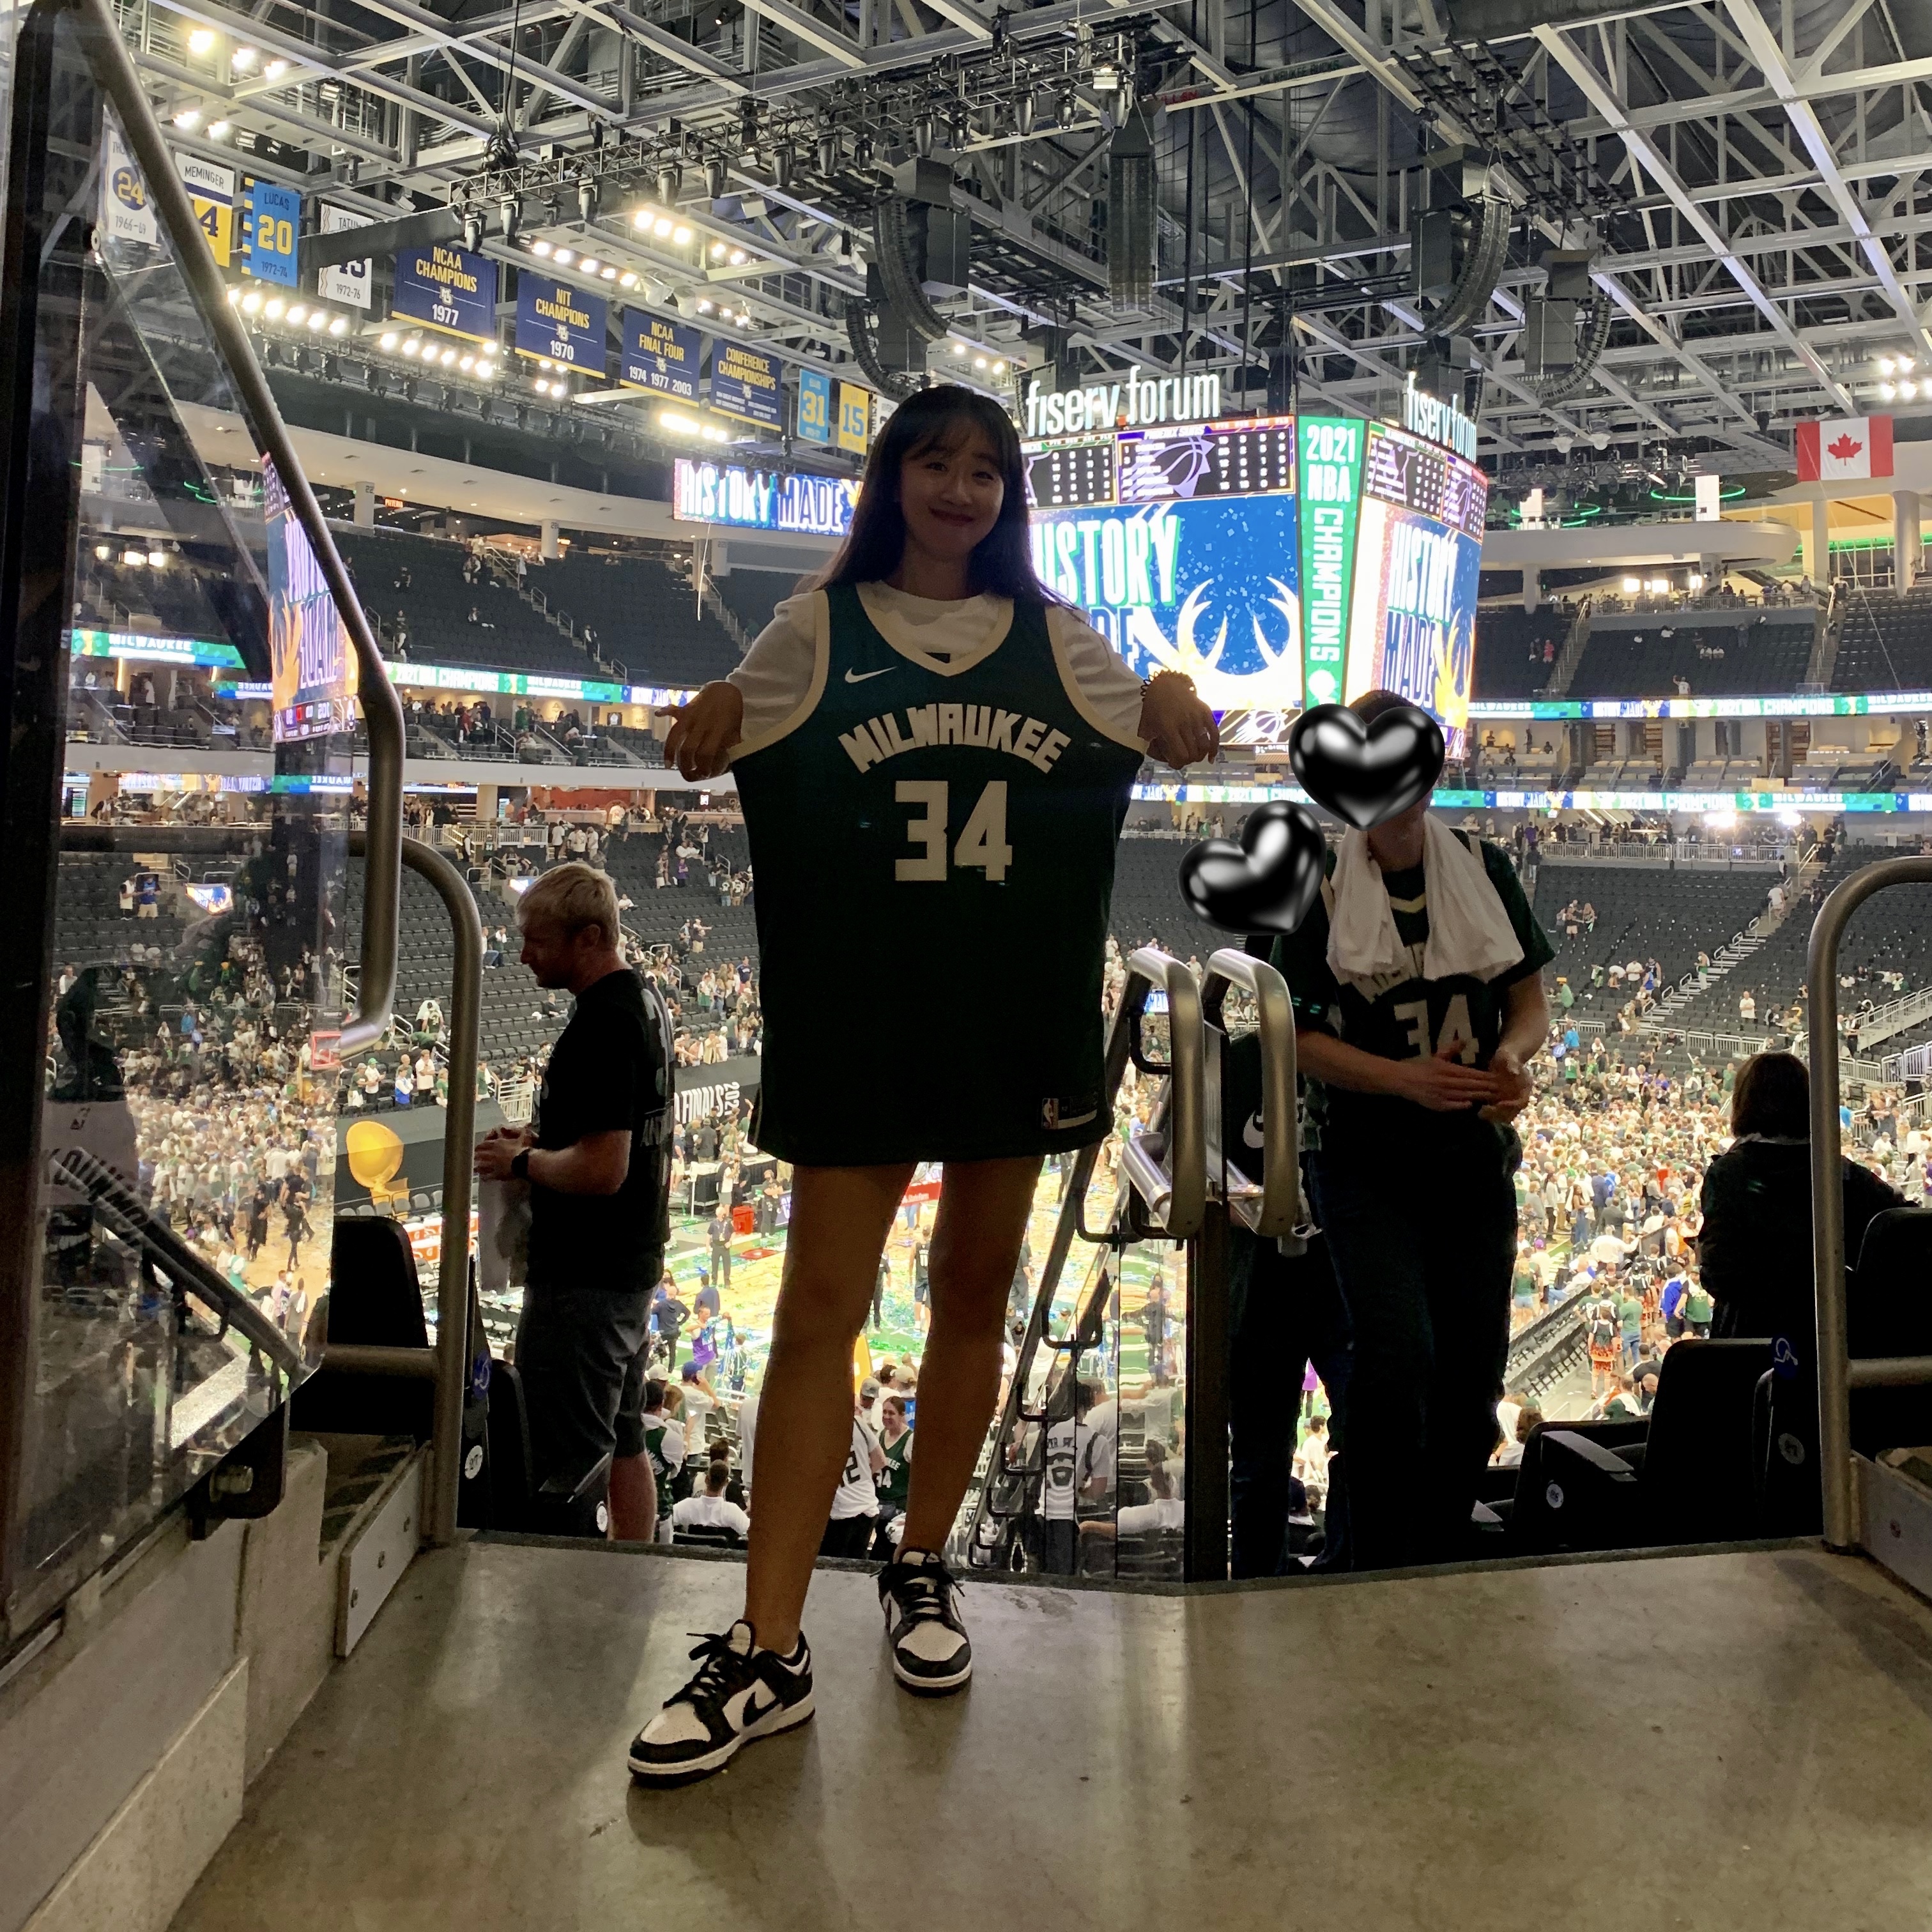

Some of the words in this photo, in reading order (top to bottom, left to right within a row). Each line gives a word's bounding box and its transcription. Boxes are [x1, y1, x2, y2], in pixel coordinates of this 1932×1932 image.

[118, 171, 144, 205] 24
[185, 166, 224, 189] MEMINGER
[264, 192, 289, 211] LUCAS
[257, 214, 293, 255] 20
[261, 261, 288, 278] 1972-74
[433, 246, 463, 271] NCAA
[416, 259, 477, 293] CHAMPIONS
[336, 284, 361, 300] 1972-76
[556, 288, 572, 307] NIT
[432, 303, 459, 326] 1977
[535, 298, 590, 329] CHAMPIONS
[651, 321, 674, 342] NCAA
[550, 340, 574, 361] 1970
[639, 334, 663, 355] FINAL
[664, 342, 684, 362] FOUR
[726, 347, 770, 374] CONFERENCE
[629, 365, 647, 383] 1974
[651, 372, 669, 388] 1977
[672, 379, 692, 396] 2003
[718, 360, 776, 391] CHAMPIONSHIPS
[801, 390, 825, 427] 31
[1026, 379, 1121, 437] fiserv
[1126, 365, 1221, 424] forum
[843, 403, 864, 437] 15
[1407, 371, 1452, 447] fiserv
[1451, 394, 1477, 464] forum
[1306, 424, 1356, 463] 2021
[1307, 463, 1351, 503] NBA
[1310, 507, 1345, 663] CHAMPIONS
[1387, 521, 1459, 625] HISTORY
[109, 634, 193, 652] MILWAUKEE
[439, 668, 500, 692] CHAMPIONS
[526, 675, 582, 690] MILWAUKEE
[1763, 698, 1835, 715] CHAMPIONS
[838, 703, 1072, 774] MILWAUKEE
[1666, 792, 1736, 810] CHAMPIONS
[1773, 793, 1843, 802] MILWAUKEE
[895, 780, 1013, 882] 34
[1393, 994, 1480, 1064] 34
[681, 1084, 724, 1124] FINALS
